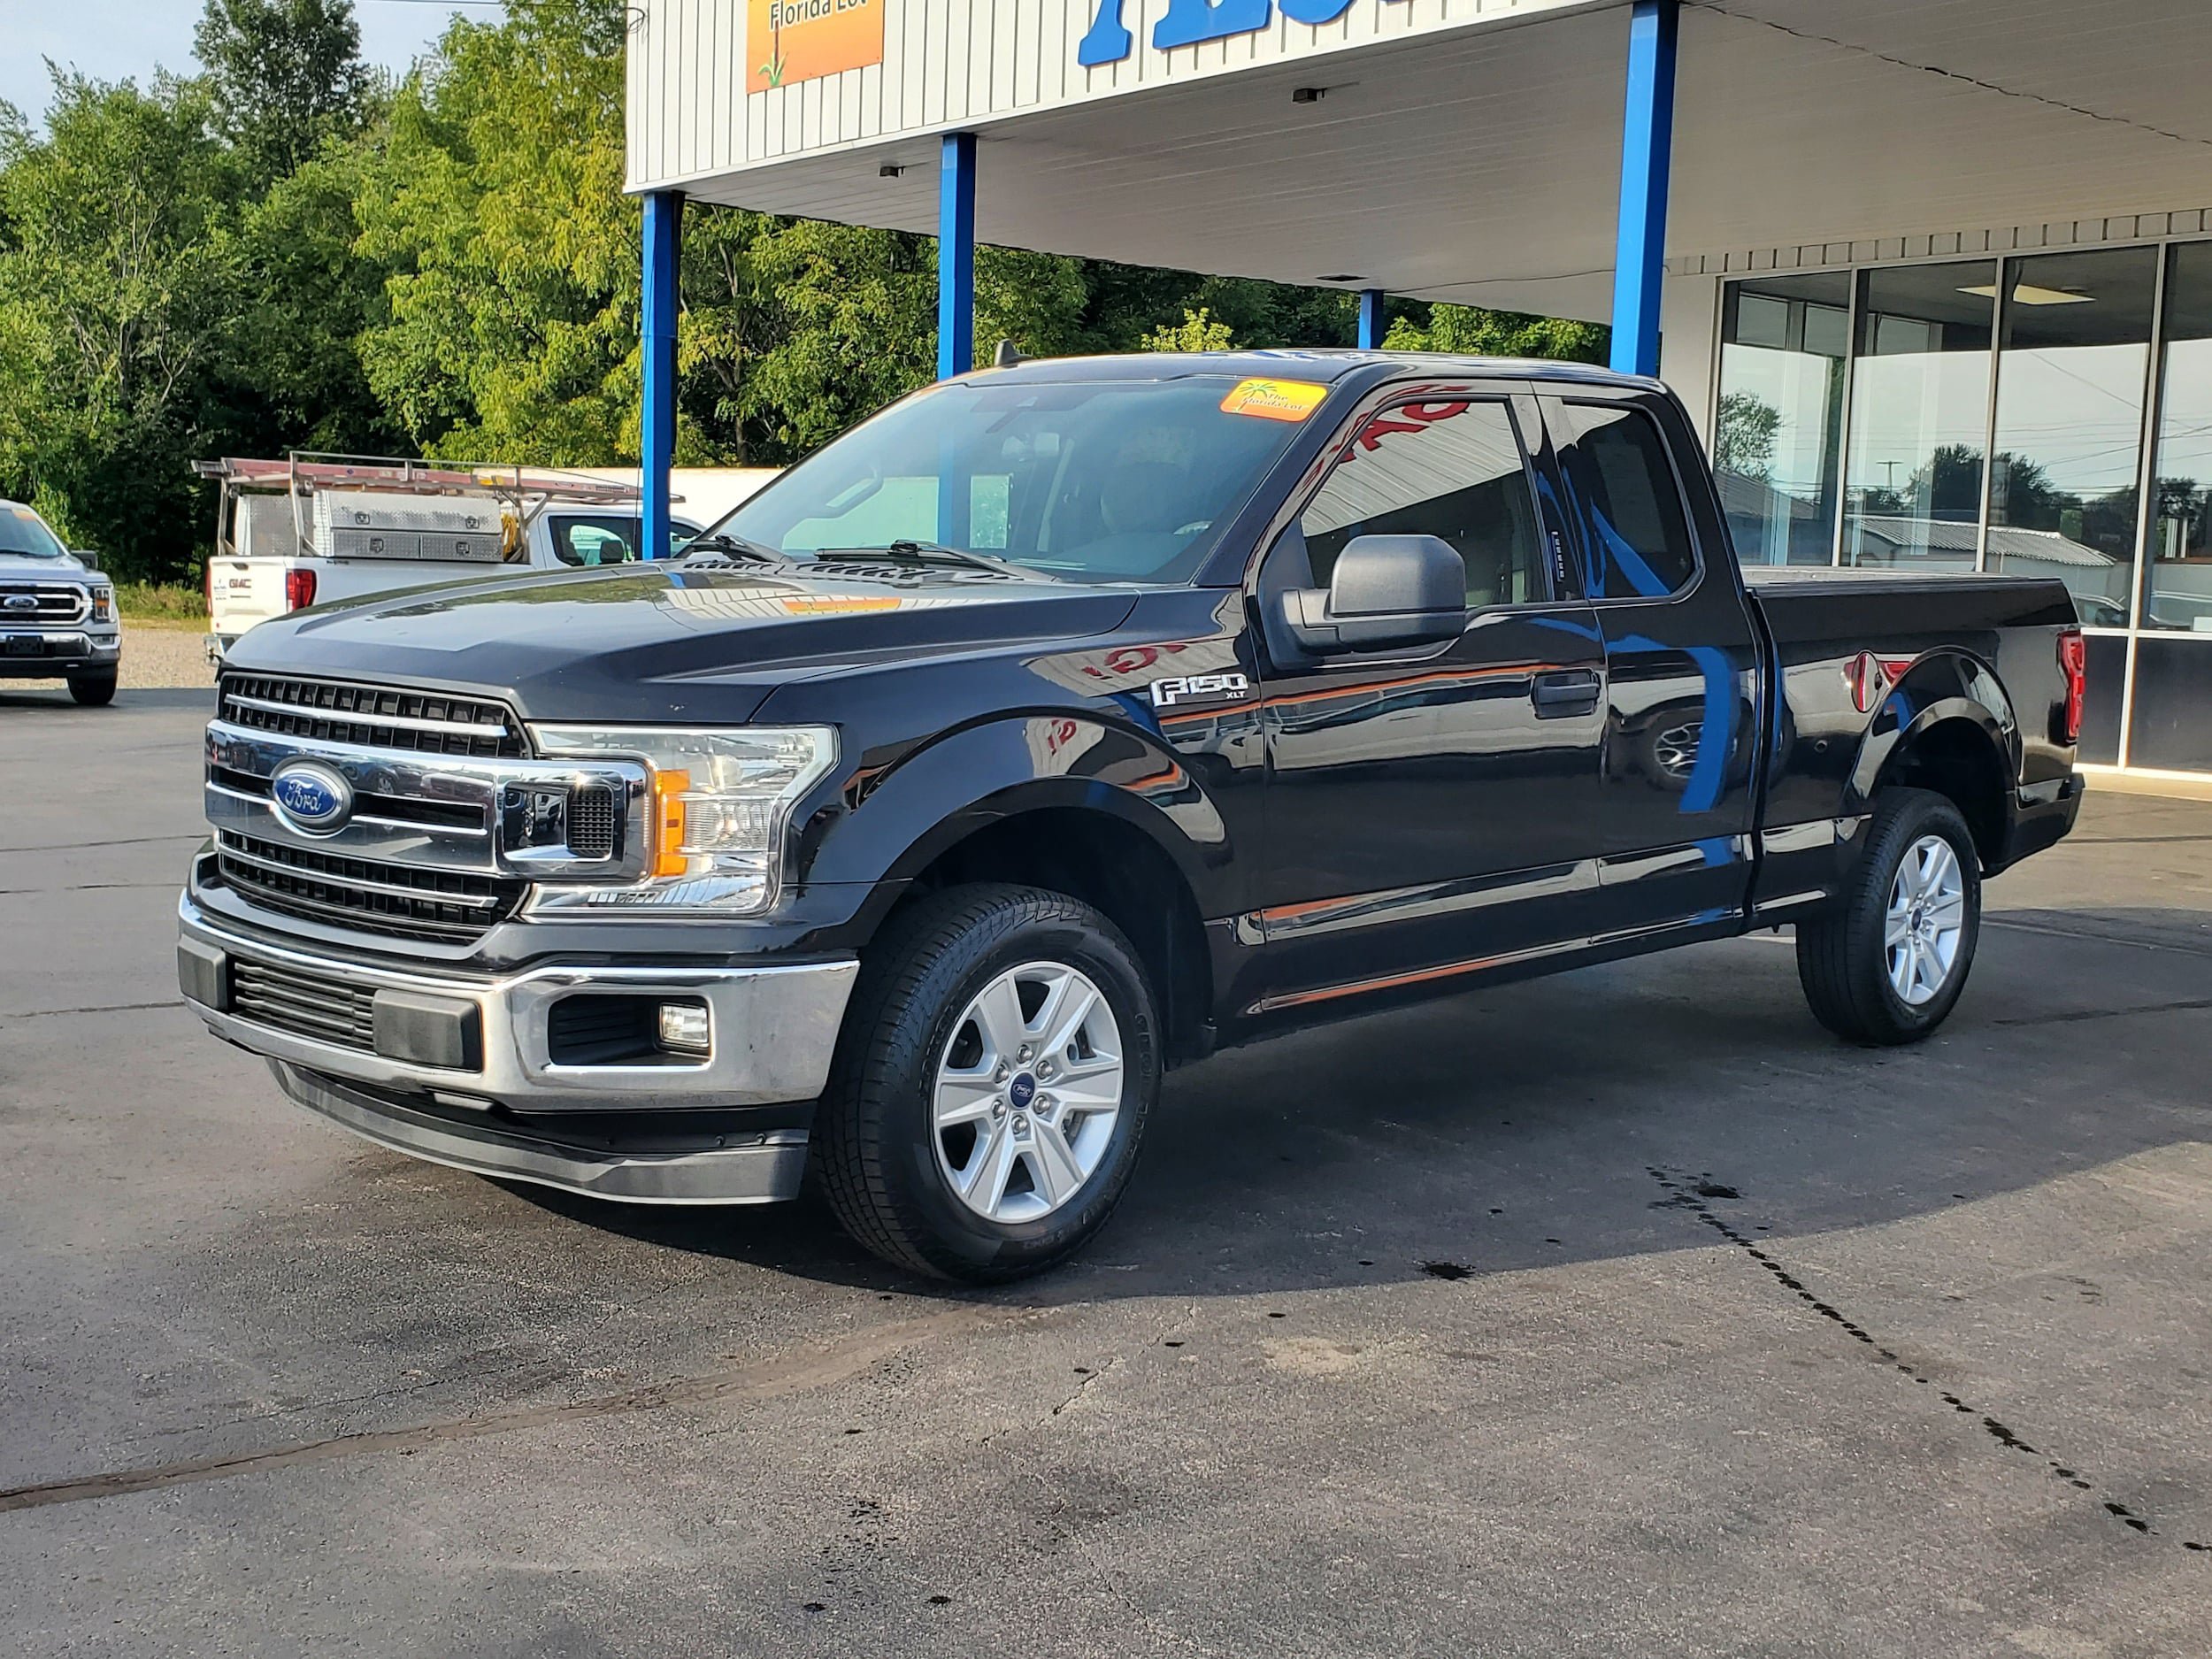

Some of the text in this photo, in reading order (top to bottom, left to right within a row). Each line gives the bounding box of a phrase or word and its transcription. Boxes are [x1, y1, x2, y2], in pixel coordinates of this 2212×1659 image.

[770, 0, 831, 30] Florida
[1242, 396, 1281, 407] Florida
[229, 579, 252, 589] GMC
[284, 779, 322, 812] Ford
